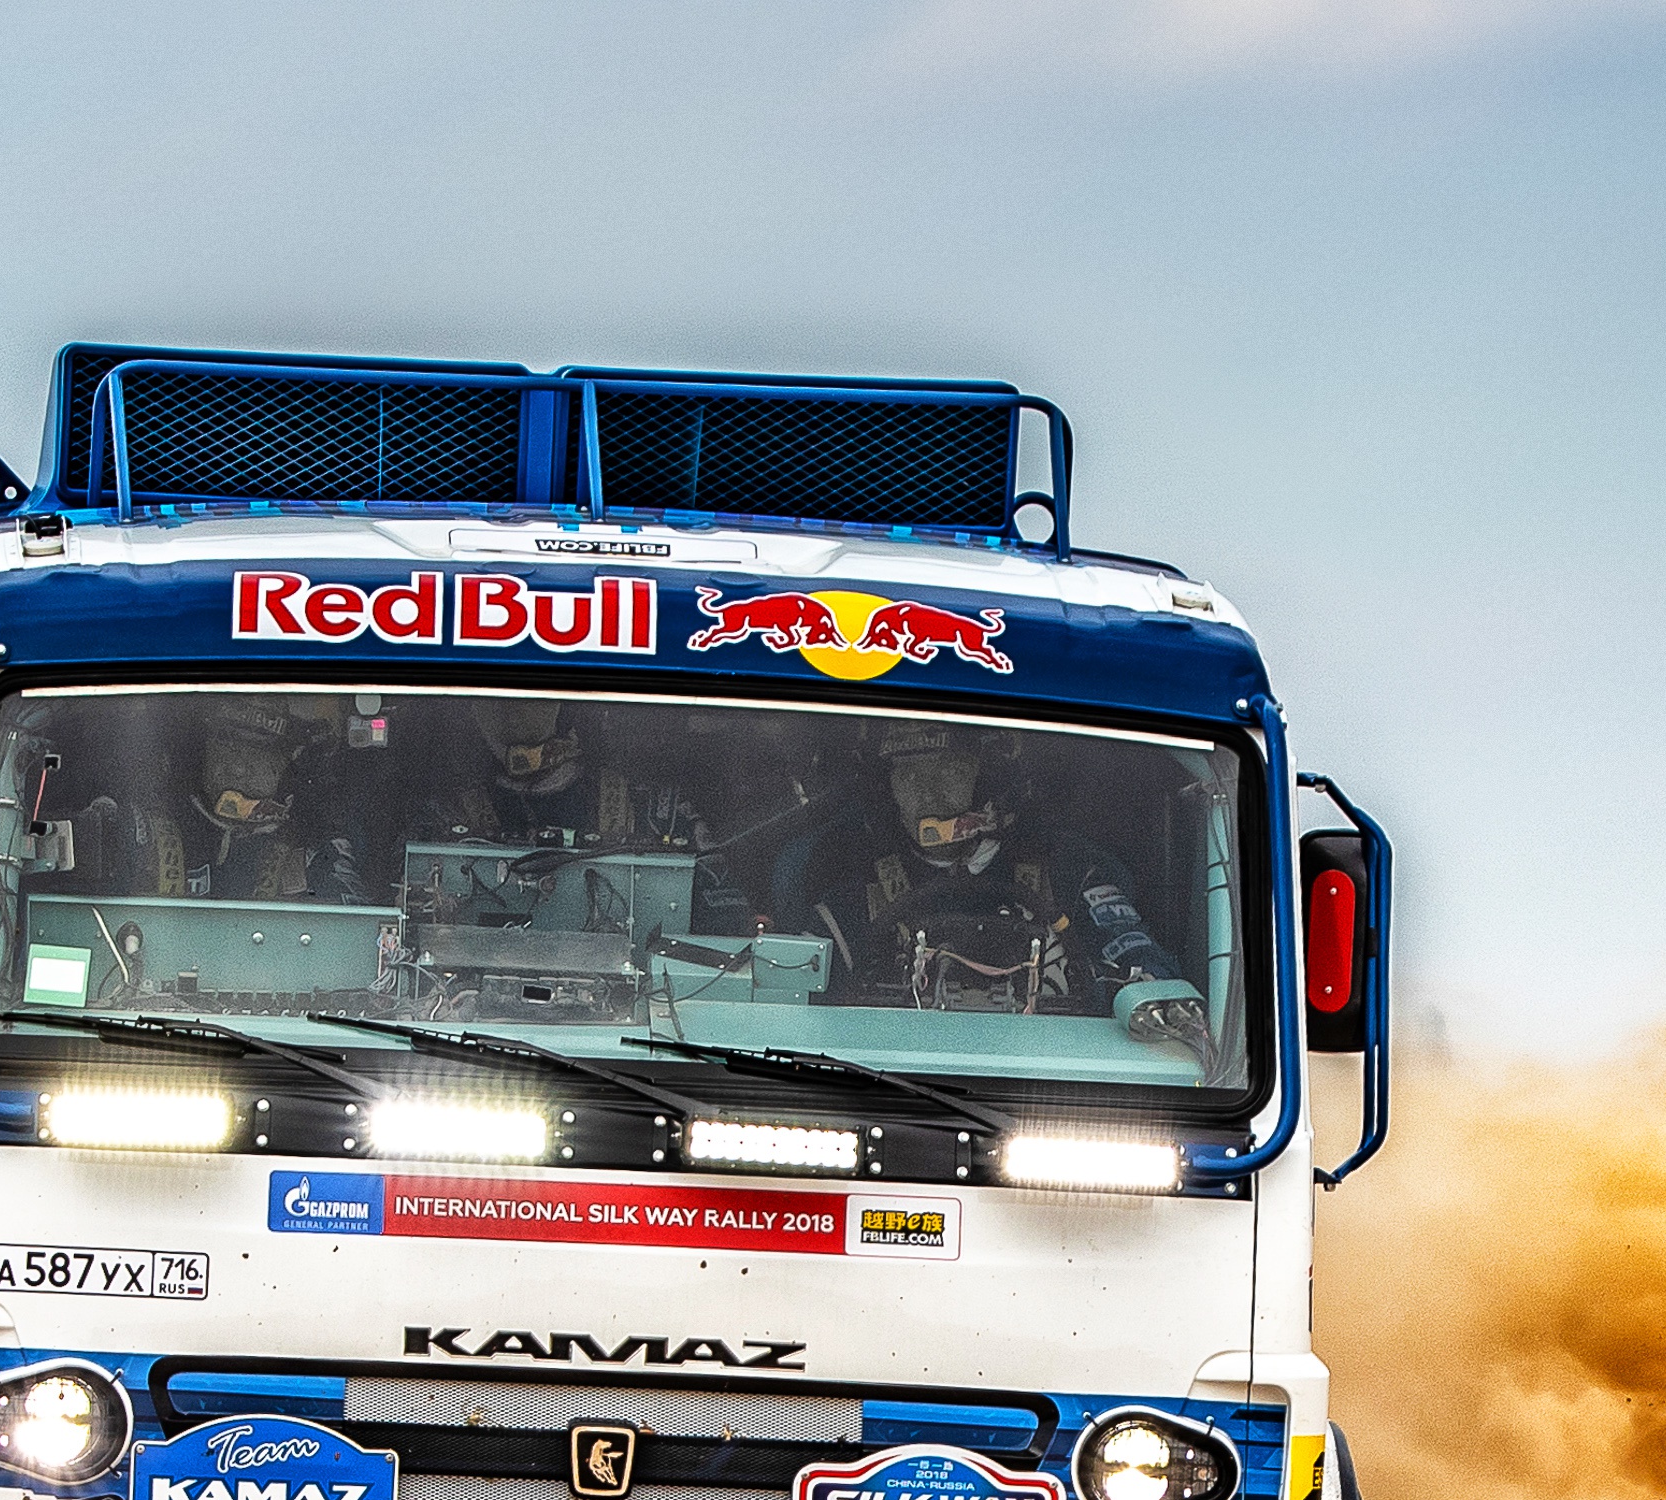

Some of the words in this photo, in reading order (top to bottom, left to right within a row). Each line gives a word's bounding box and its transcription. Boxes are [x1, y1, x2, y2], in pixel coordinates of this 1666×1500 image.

[538, 540, 668, 555] FBLIFE.COM
[236, 572, 440, 641] Red
[457, 575, 653, 651] Bull
[309, 1202, 369, 1219] GAZPROM
[395, 1196, 583, 1222] INTERNATIONAL
[588, 1203, 639, 1225] SILK
[645, 1206, 698, 1227] WAY
[704, 1209, 777, 1230] RALLY
[783, 1212, 835, 1232] 2018
[284, 1220, 324, 1229] GENERAL
[328, 1222, 369, 1231] PARTNER
[862, 1231, 942, 1245] FBLIFE.COM
[160, 1258, 200, 1281] 716
[159, 1283, 185, 1294] RUS
[404, 1326, 807, 1372] KAMAZ
[208, 1425, 319, 1473] Team
[915, 1470, 948, 1479] 2018
